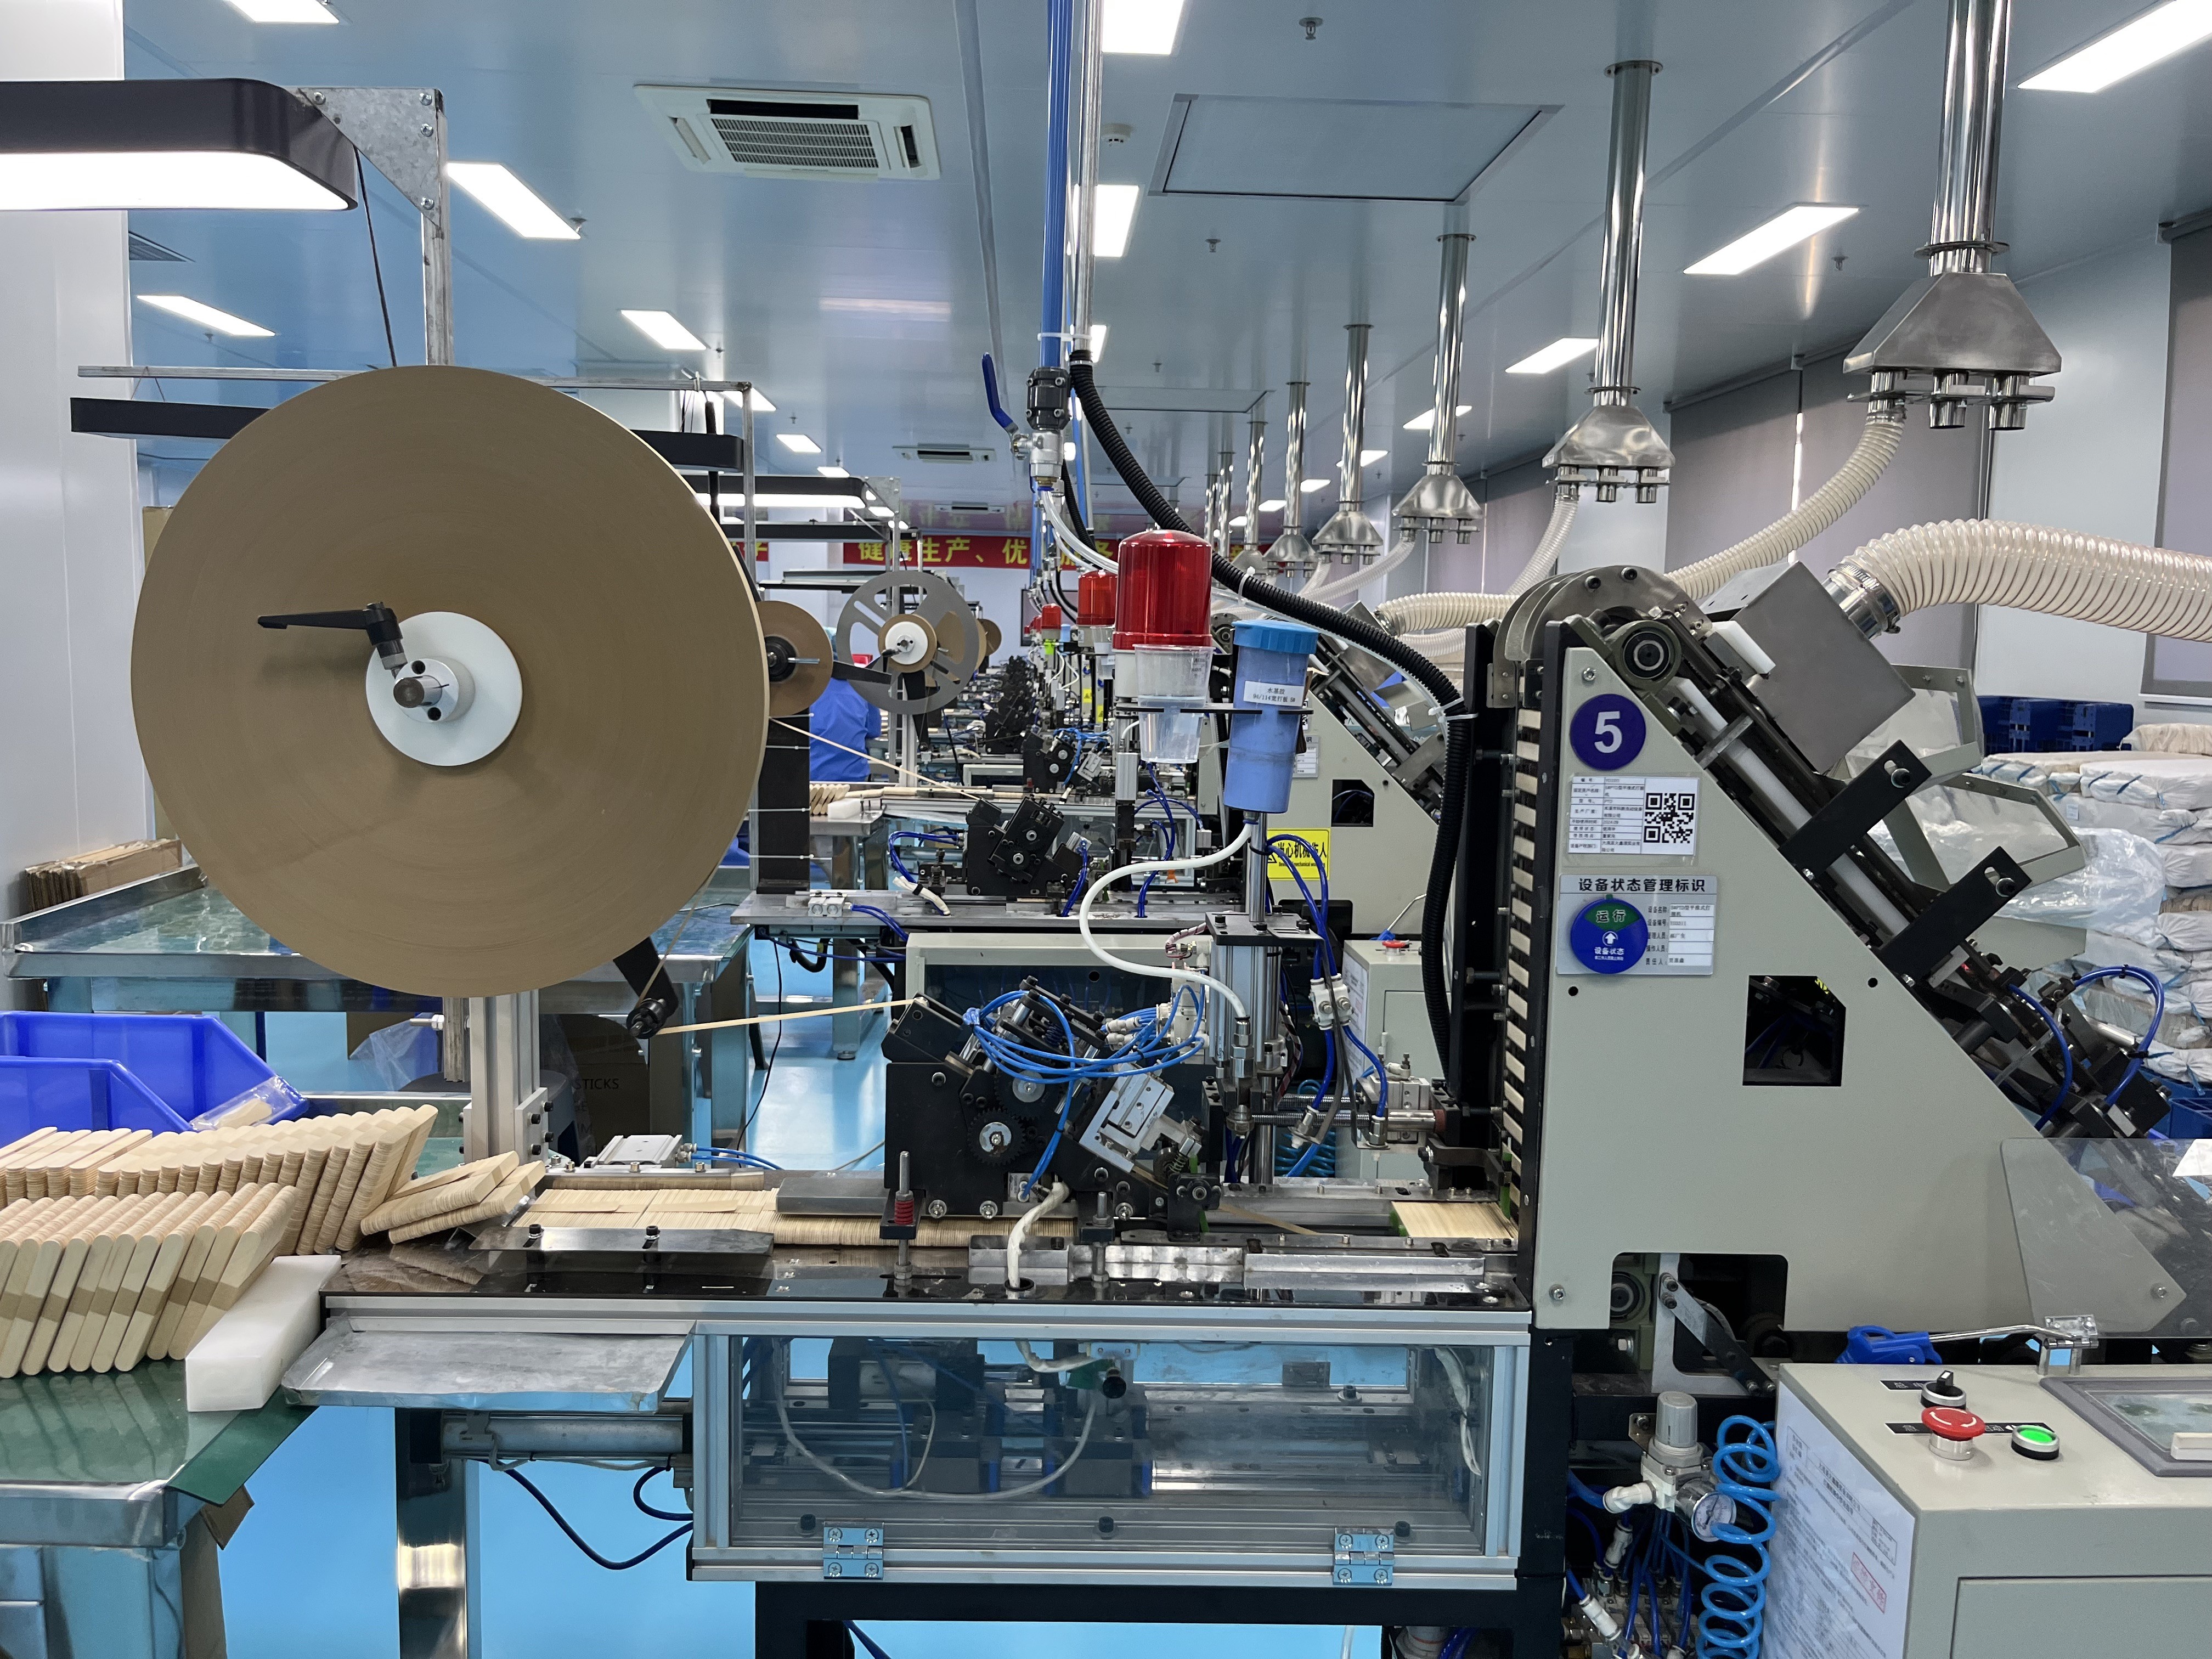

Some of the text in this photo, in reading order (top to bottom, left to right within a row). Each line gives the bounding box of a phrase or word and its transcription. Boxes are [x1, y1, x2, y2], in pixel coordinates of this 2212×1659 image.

[1594, 711, 1623, 753] 5
[1578, 878, 1706, 893] 设备状态管理标识
[1595, 909, 1626, 923] 运行
[1594, 946, 1624, 956] 设备状态
[574, 1078, 619, 1090] STICKS
